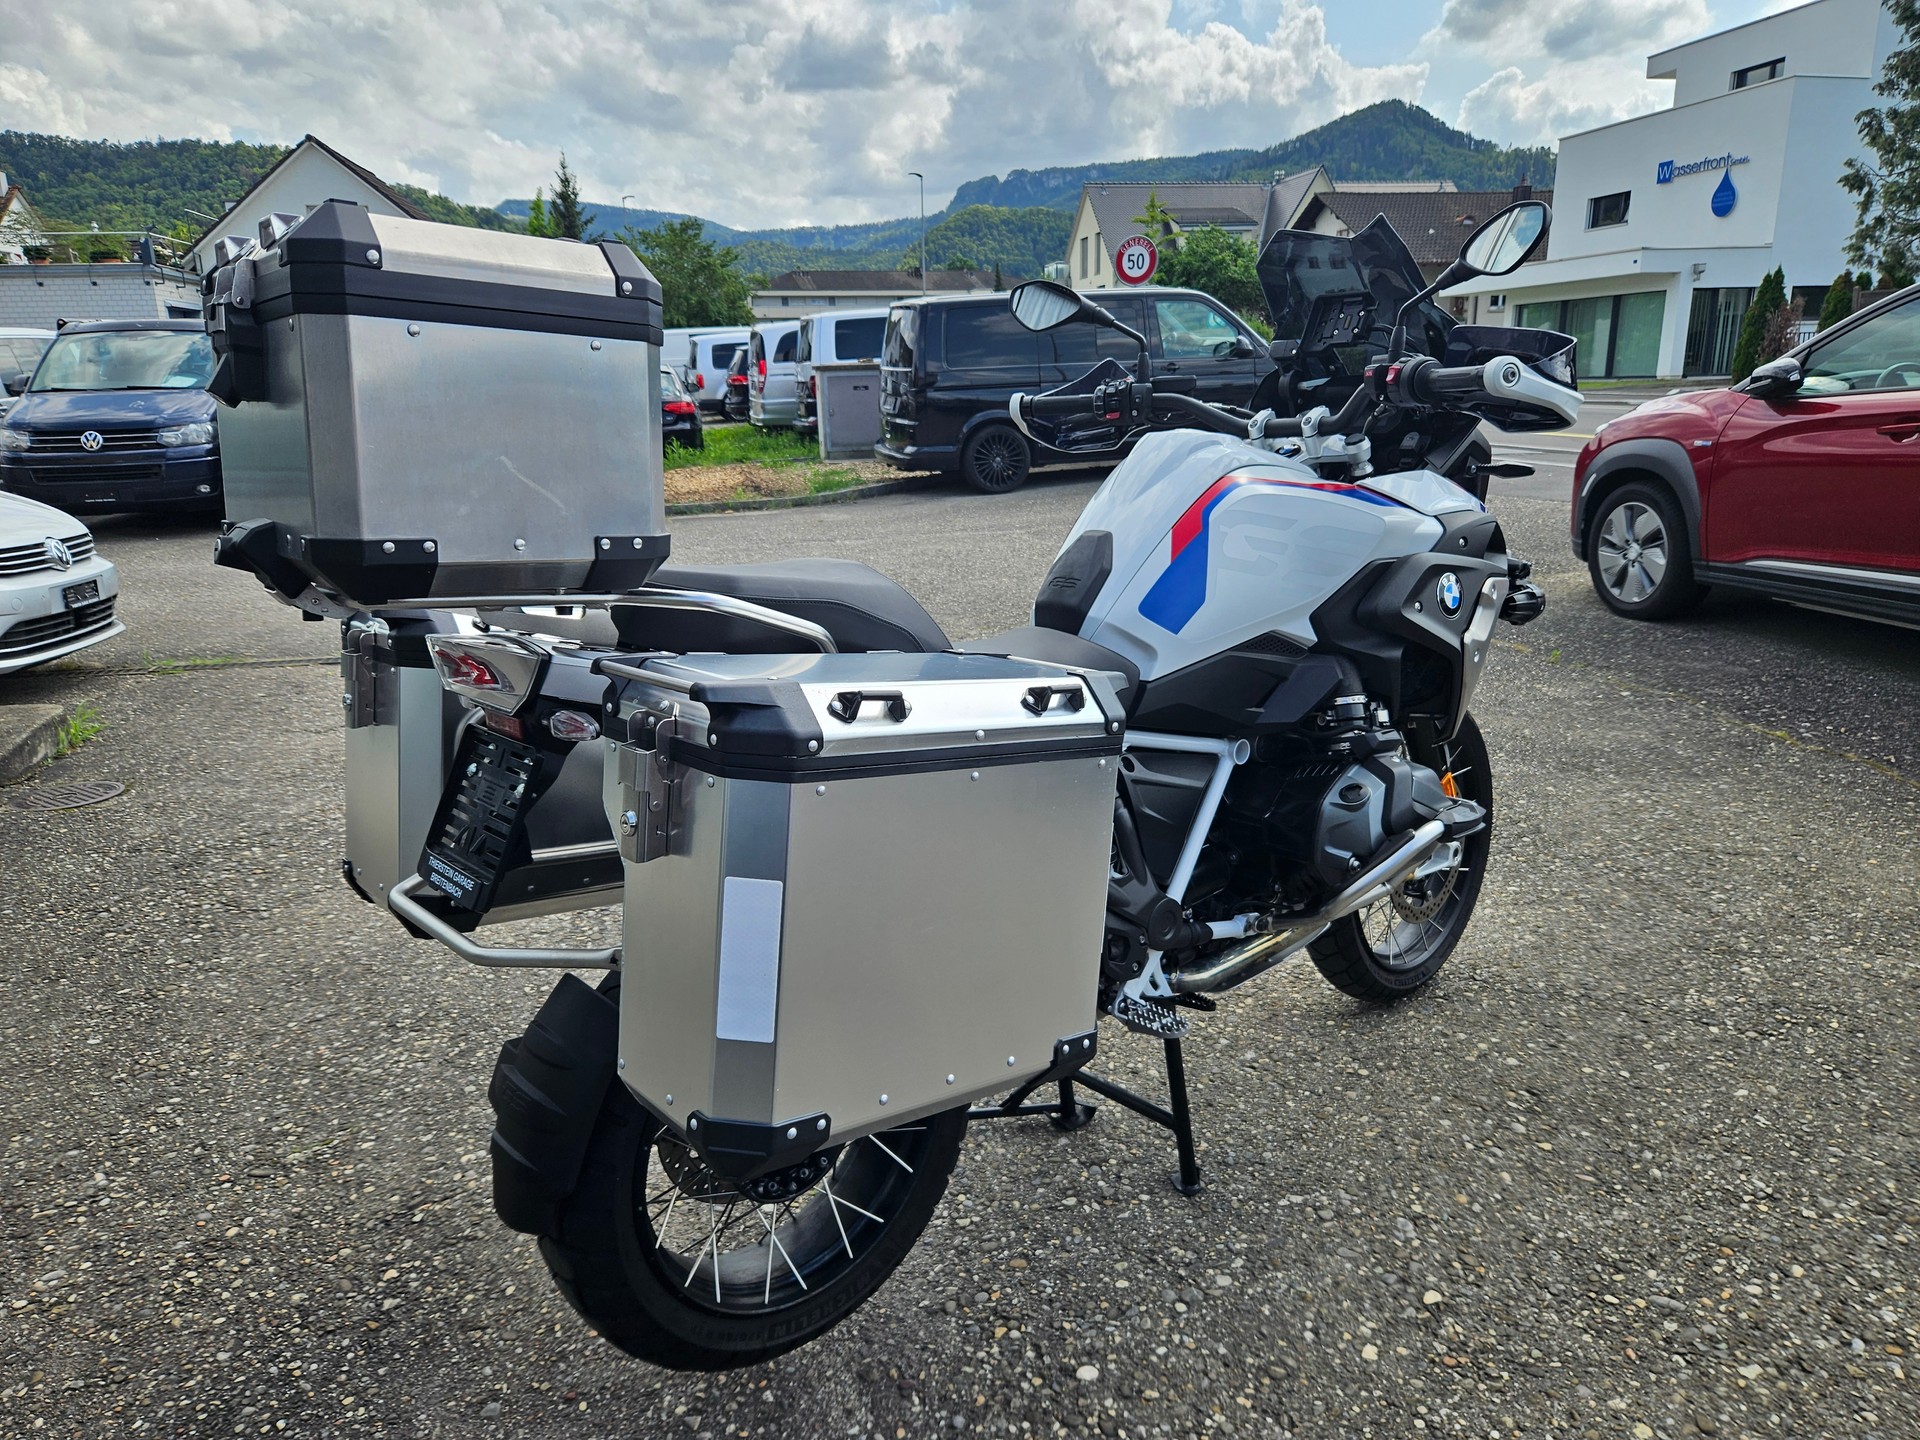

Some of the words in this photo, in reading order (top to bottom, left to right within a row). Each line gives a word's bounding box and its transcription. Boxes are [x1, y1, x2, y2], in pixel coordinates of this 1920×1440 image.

[1657, 151, 1731, 184] Wasserfront
[1120, 238, 1154, 254] GENERELL
[1127, 253, 1145, 270] 50
[1048, 576, 1081, 589] GS
[428, 855, 455, 879] THIERSTEIN
[452, 871, 475, 891] GARAGE
[430, 871, 463, 899] BREITENBACH
[773, 1270, 876, 1337] MICHELIN
